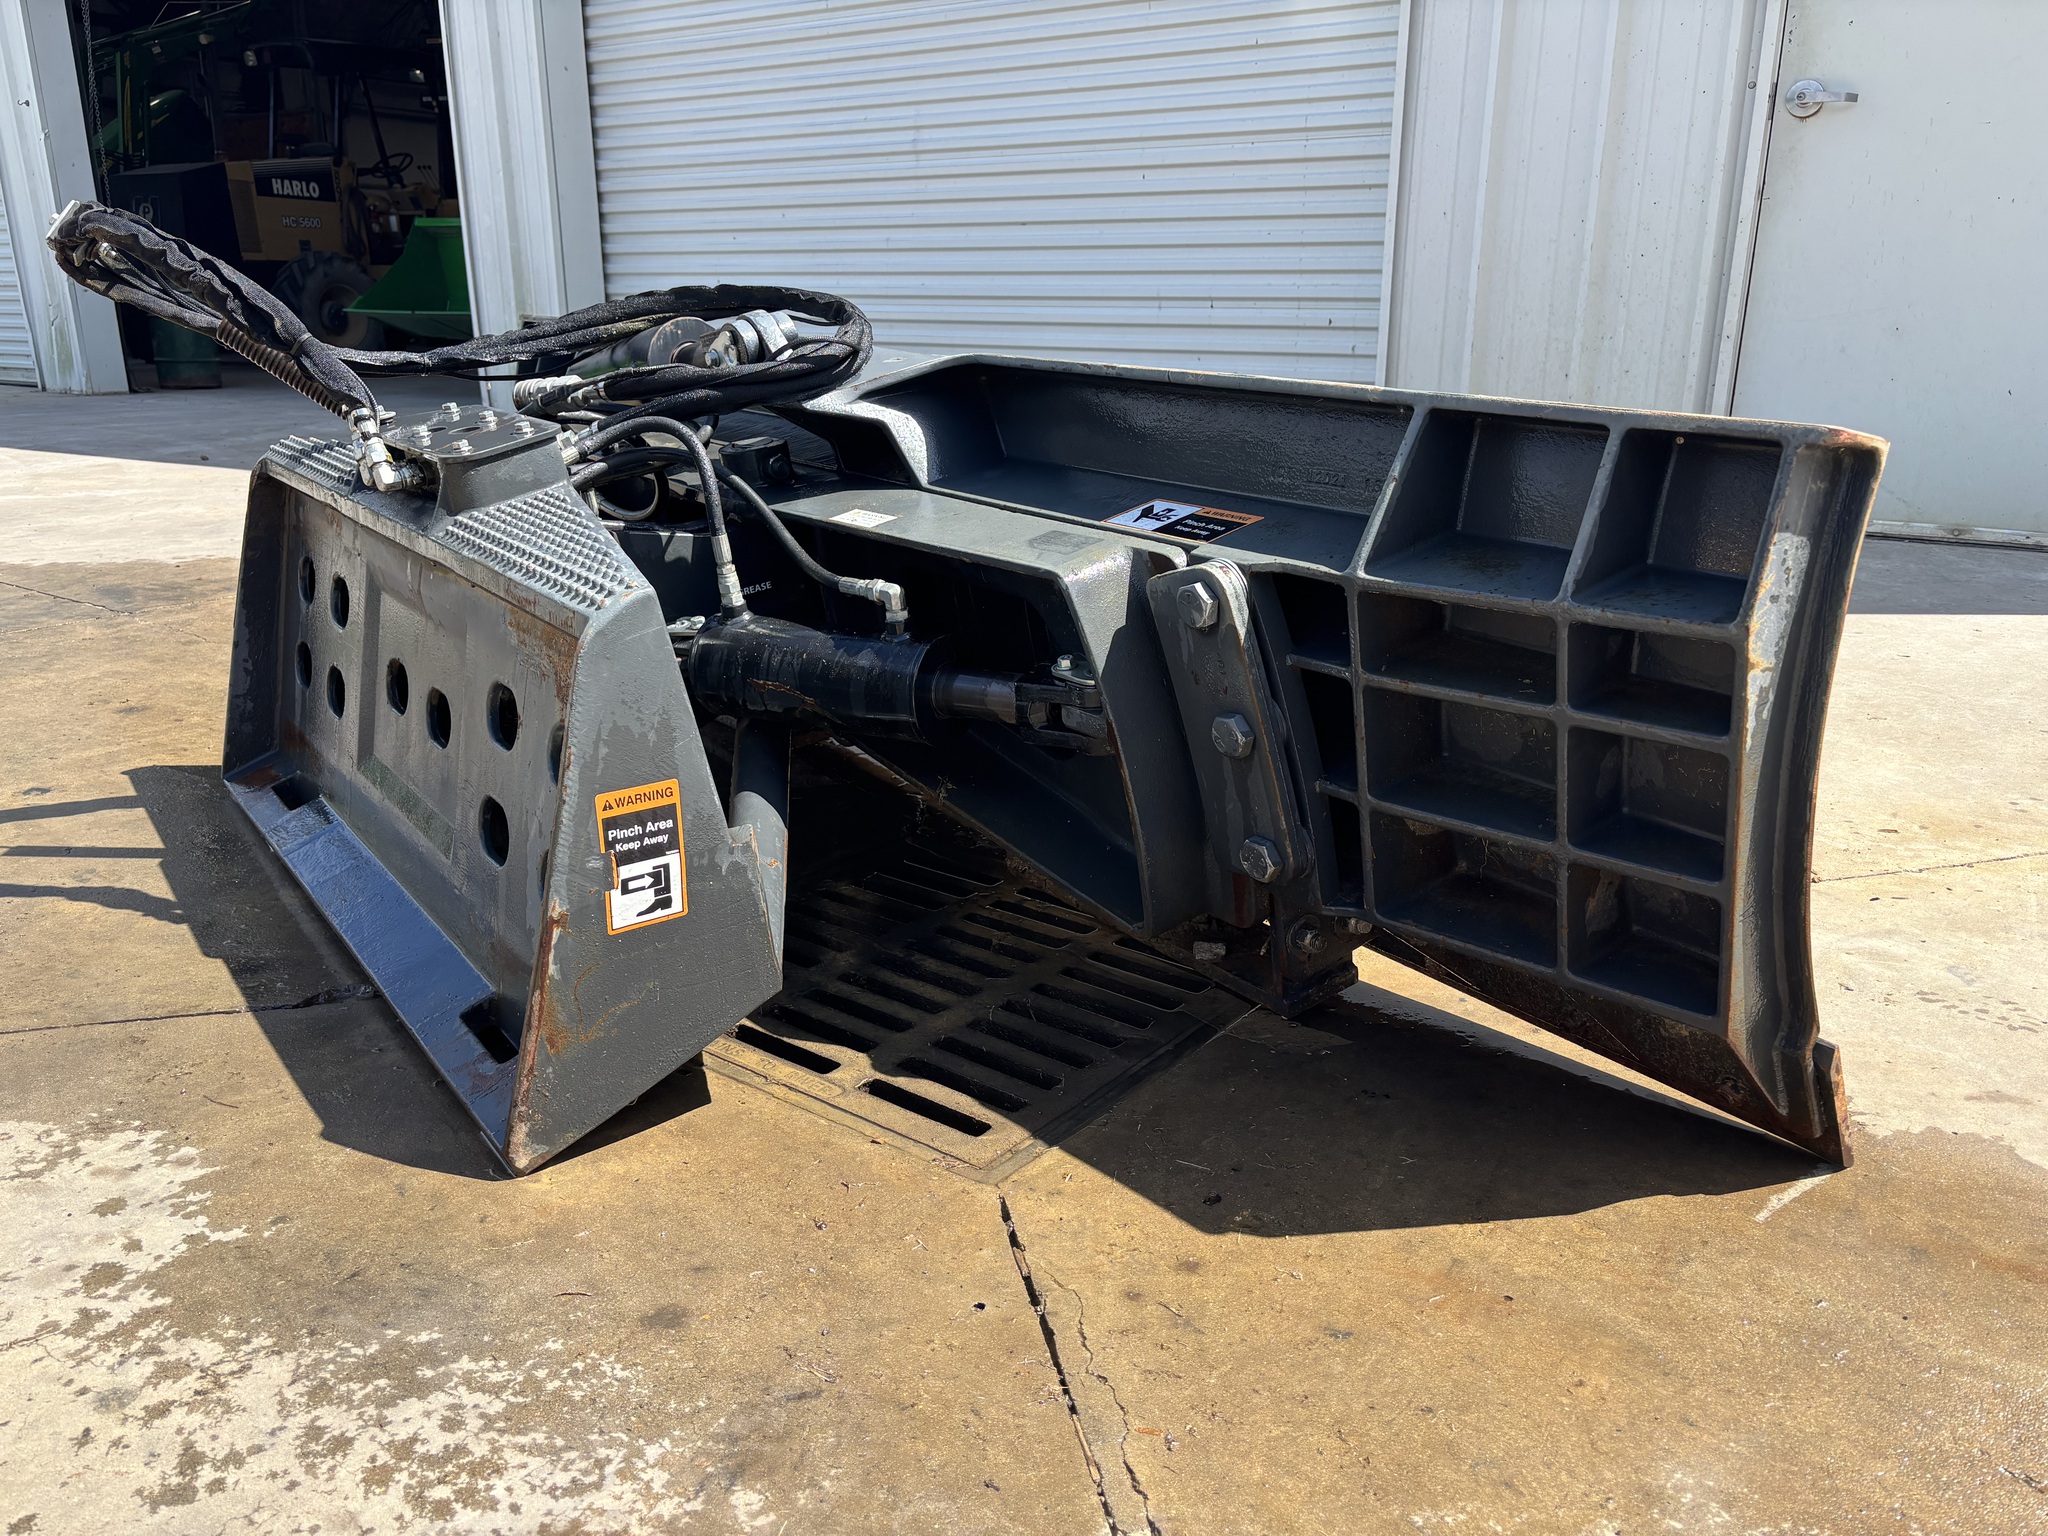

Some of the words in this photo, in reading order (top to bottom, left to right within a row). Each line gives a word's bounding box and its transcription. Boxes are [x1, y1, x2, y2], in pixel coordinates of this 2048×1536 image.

[271, 178, 320, 198] HARLO
[282, 216, 297, 228] HC
[299, 217, 322, 229] 5600
[1182, 519, 1206, 528] Pinch
[1204, 523, 1226, 531] Area
[1211, 511, 1251, 521] WARNING
[614, 787, 675, 808] WARNING
[608, 825, 643, 841] Pinch
[645, 819, 674, 833] Area
[615, 840, 641, 852] Keep
[643, 834, 669, 847] Away
